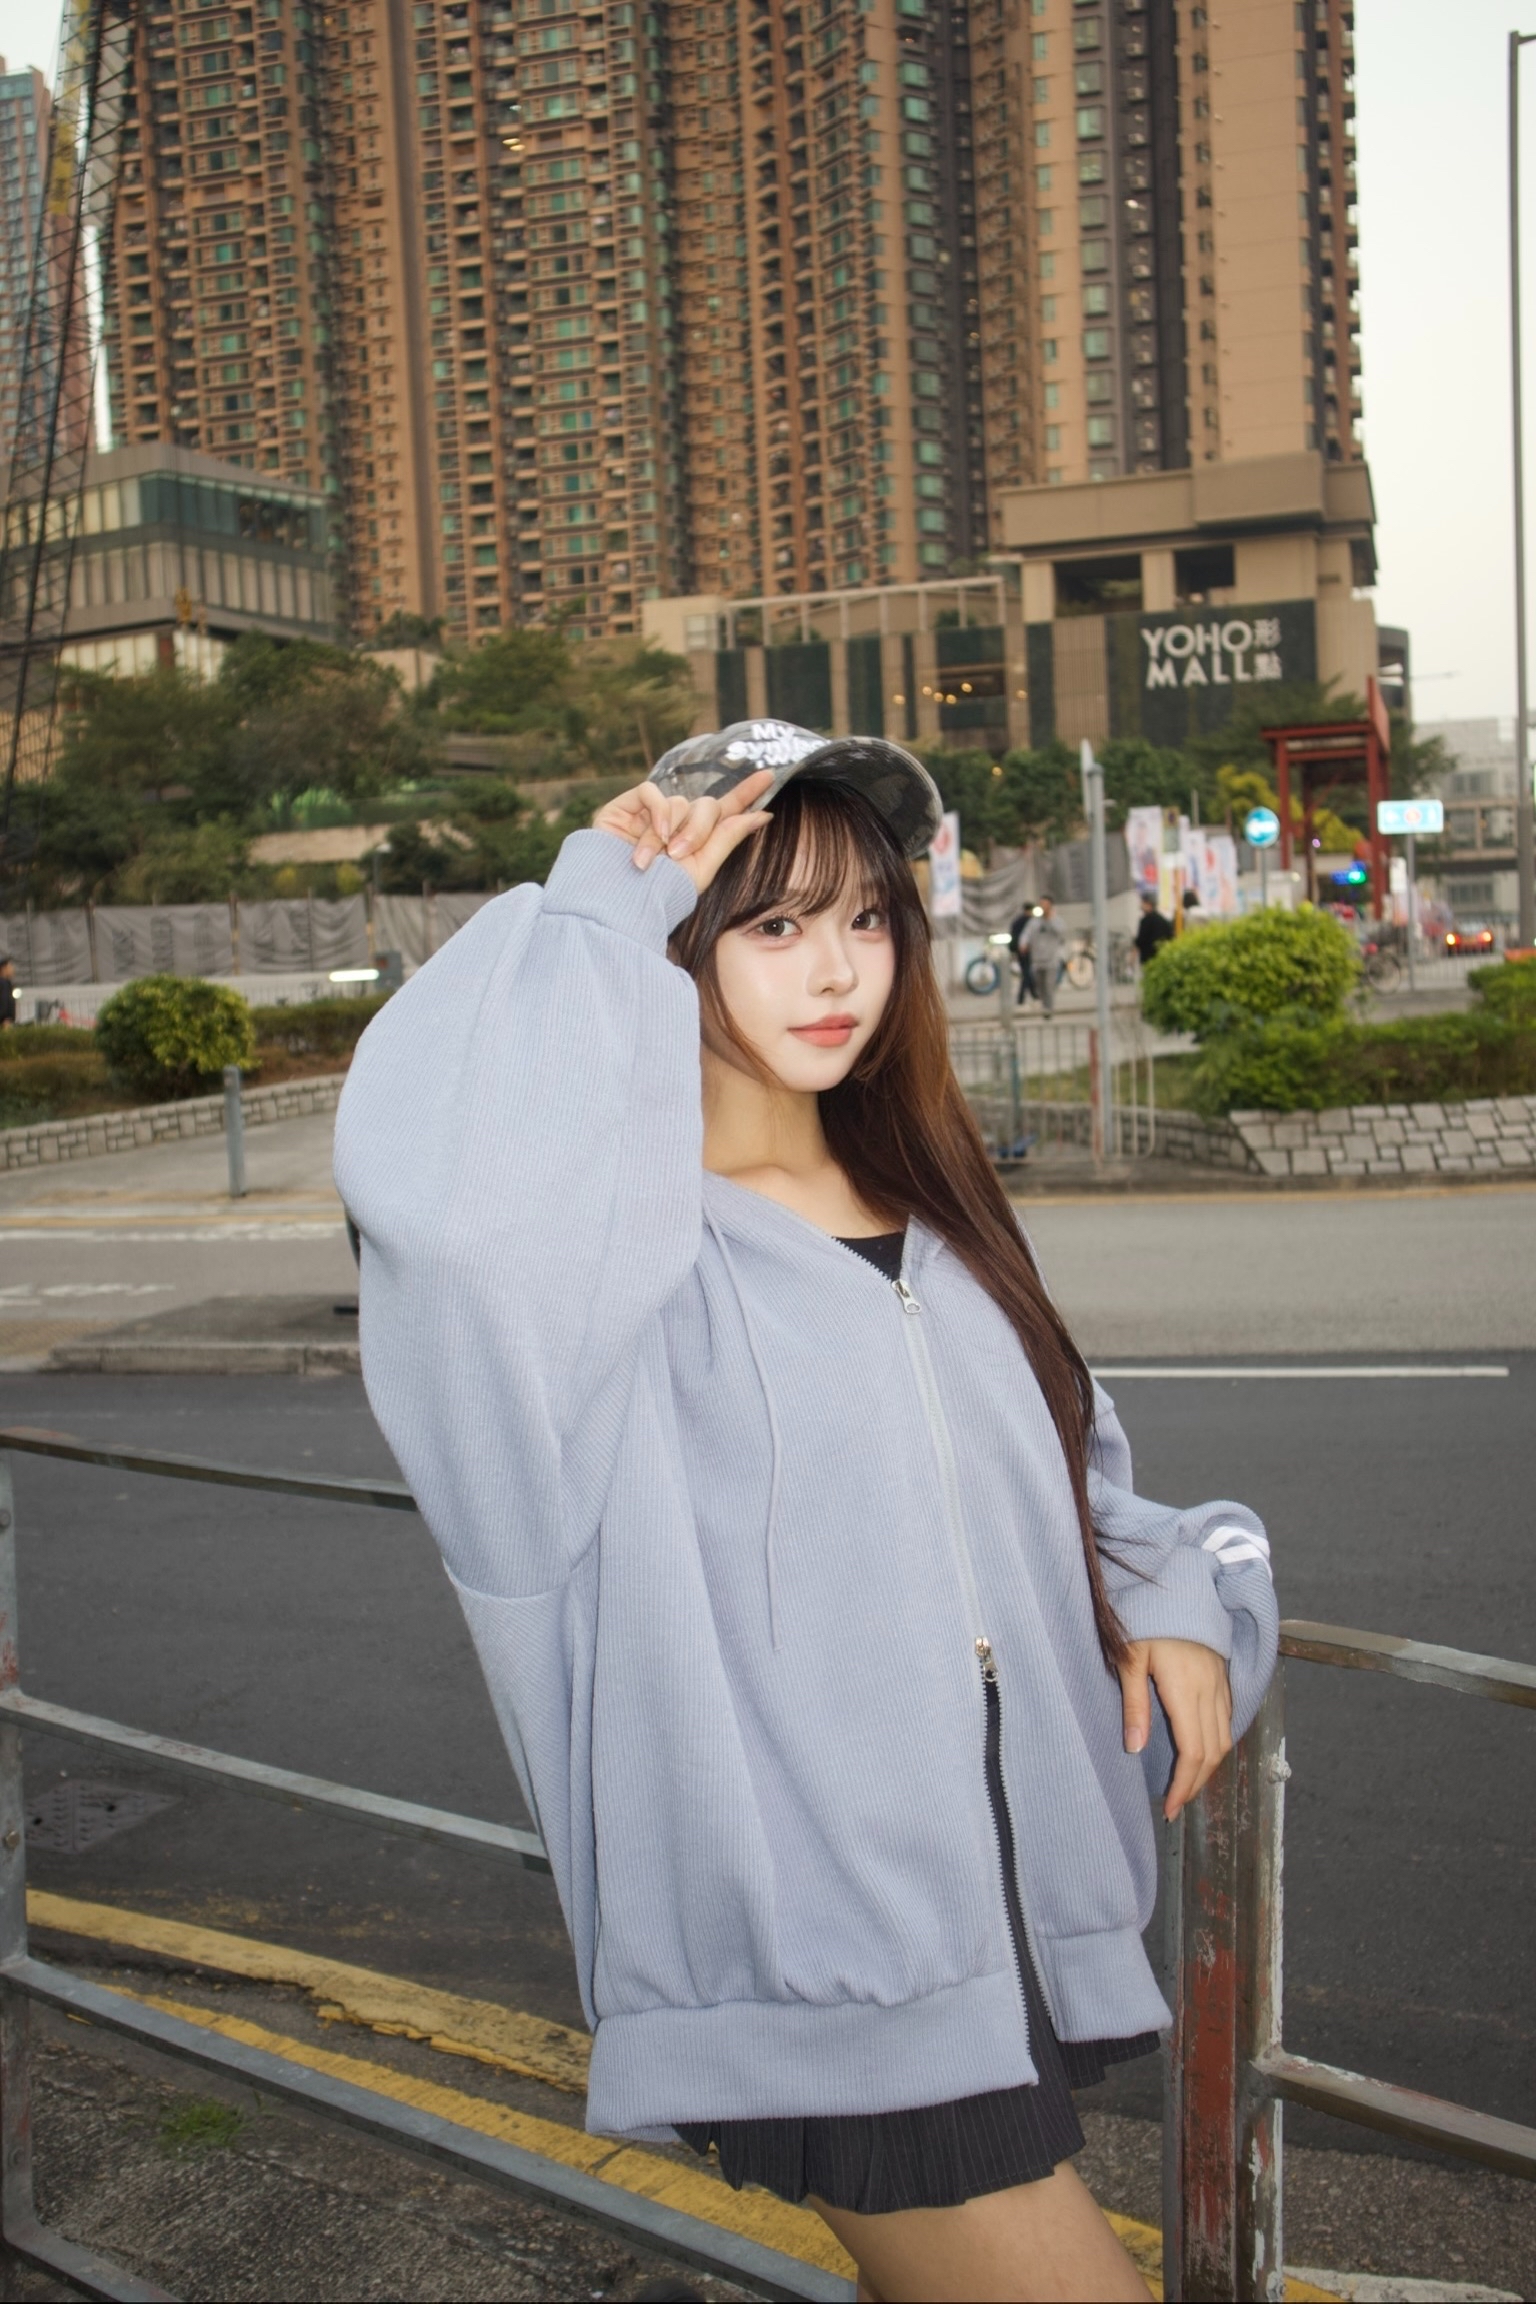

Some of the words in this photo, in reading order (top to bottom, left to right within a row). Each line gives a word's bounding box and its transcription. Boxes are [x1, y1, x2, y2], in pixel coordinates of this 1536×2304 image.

[1141, 620, 1252, 659] YOHO
[1146, 651, 1253, 689] MALL
[751, 723, 796, 742] My
